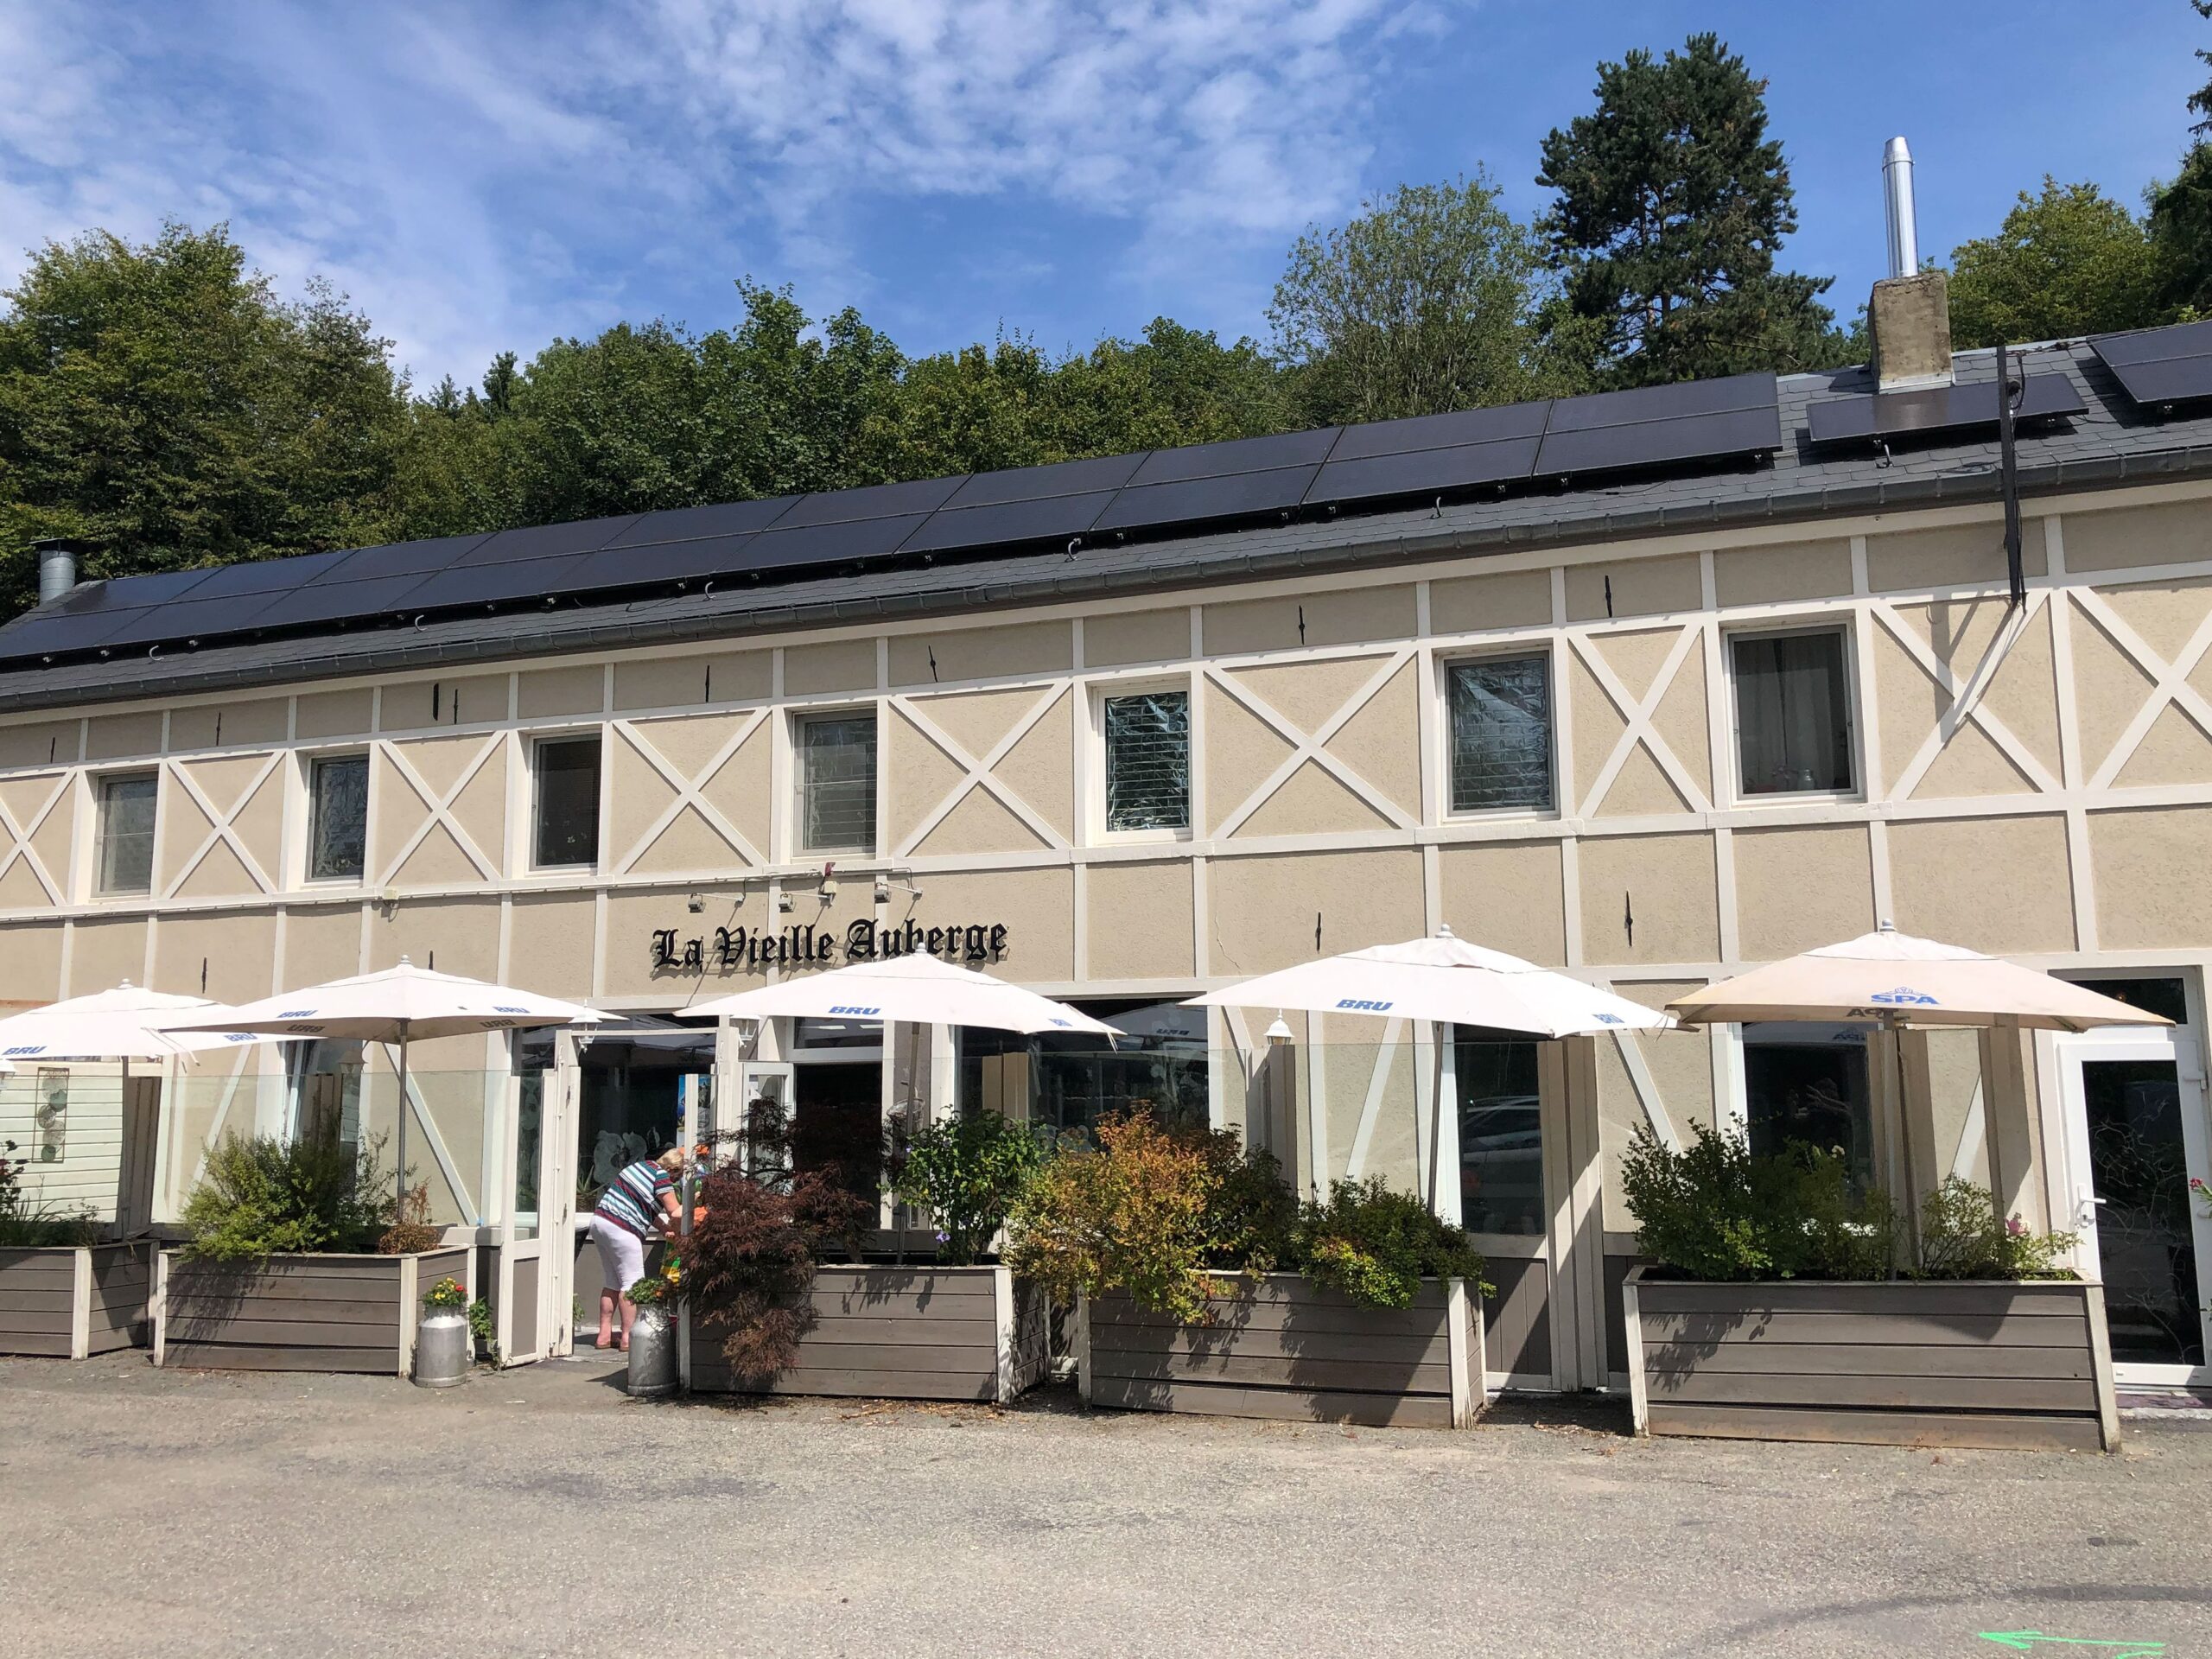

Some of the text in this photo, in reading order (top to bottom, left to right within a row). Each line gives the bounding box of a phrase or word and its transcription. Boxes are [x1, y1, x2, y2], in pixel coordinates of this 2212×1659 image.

[653, 918, 1008, 973] La Vieille Auberge
[1871, 994, 1941, 1005] SPA
[1335, 999, 1394, 1011] BRU
[276, 1009, 318, 1018] BRU
[492, 1006, 531, 1014] BRU
[829, 1006, 880, 1015] BRU
[224, 1032, 258, 1042] BRU
[3, 1046, 48, 1055] BRU
